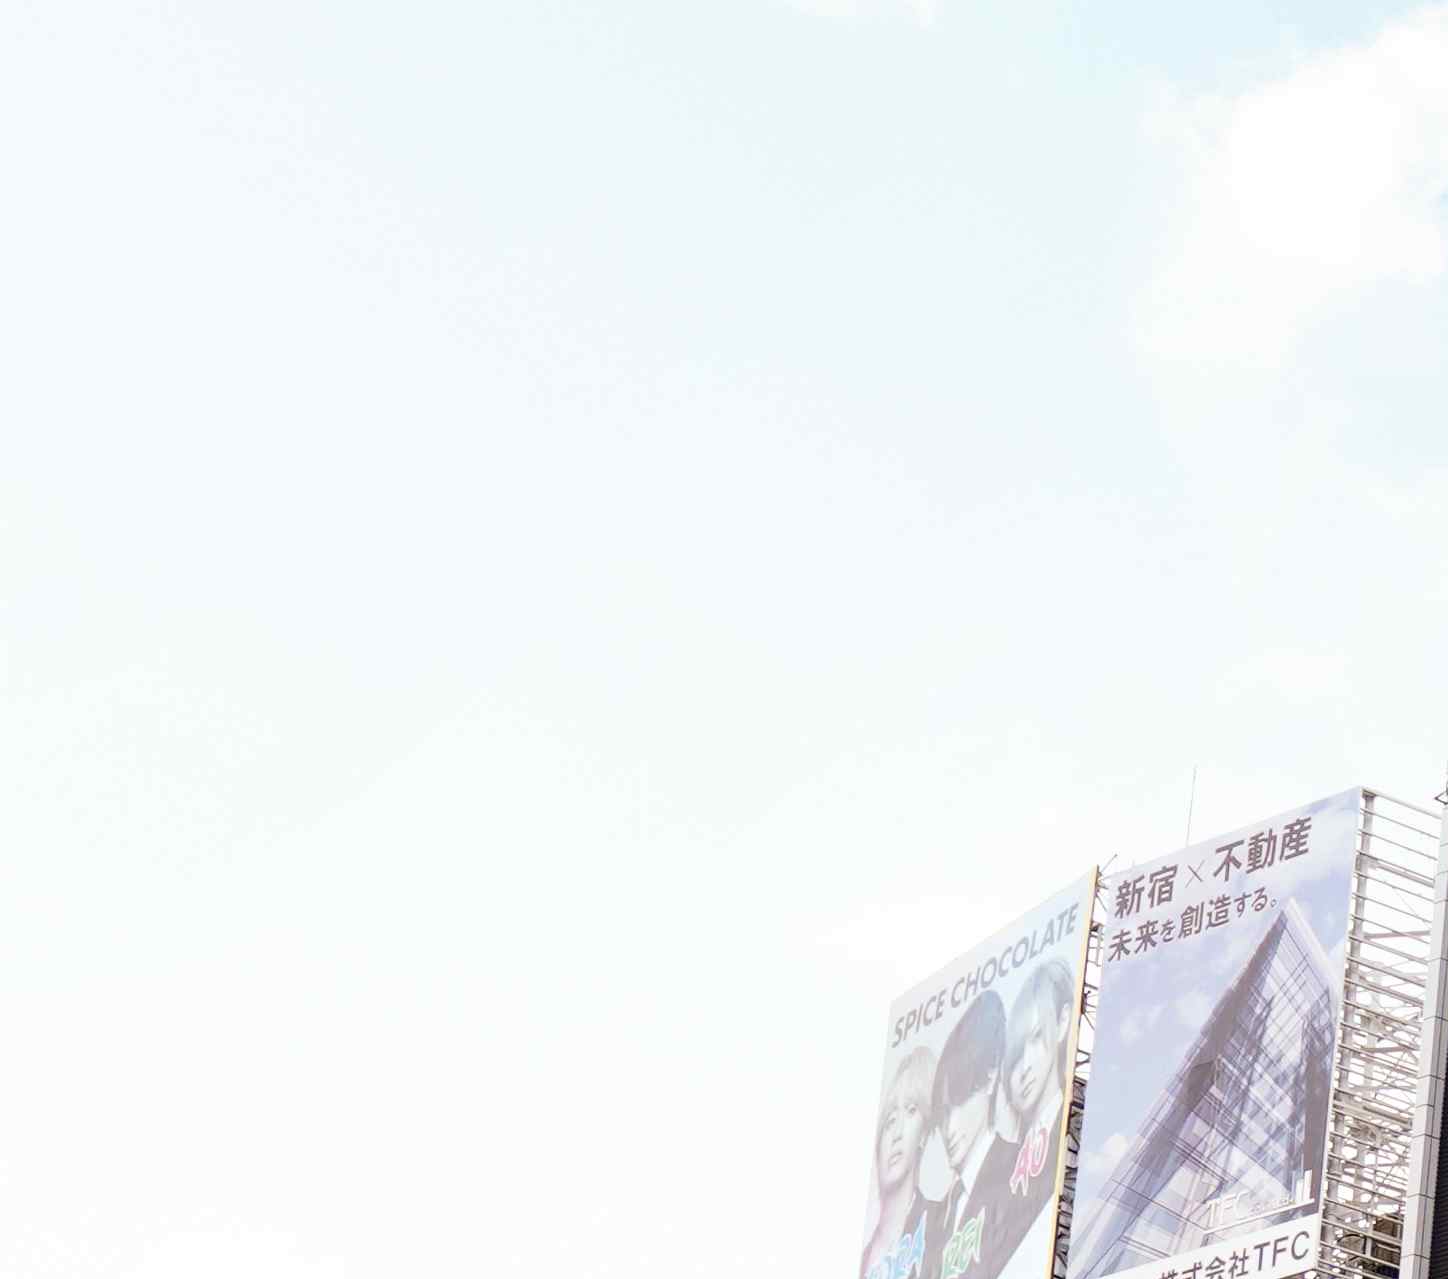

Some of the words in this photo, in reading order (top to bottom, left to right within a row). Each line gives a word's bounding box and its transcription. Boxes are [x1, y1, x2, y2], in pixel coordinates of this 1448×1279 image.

[892, 992, 948, 1049] SPICE
[951, 902, 1079, 1010] CHOCOLATE
[1107, 889, 1278, 964] 未来を創造する。
